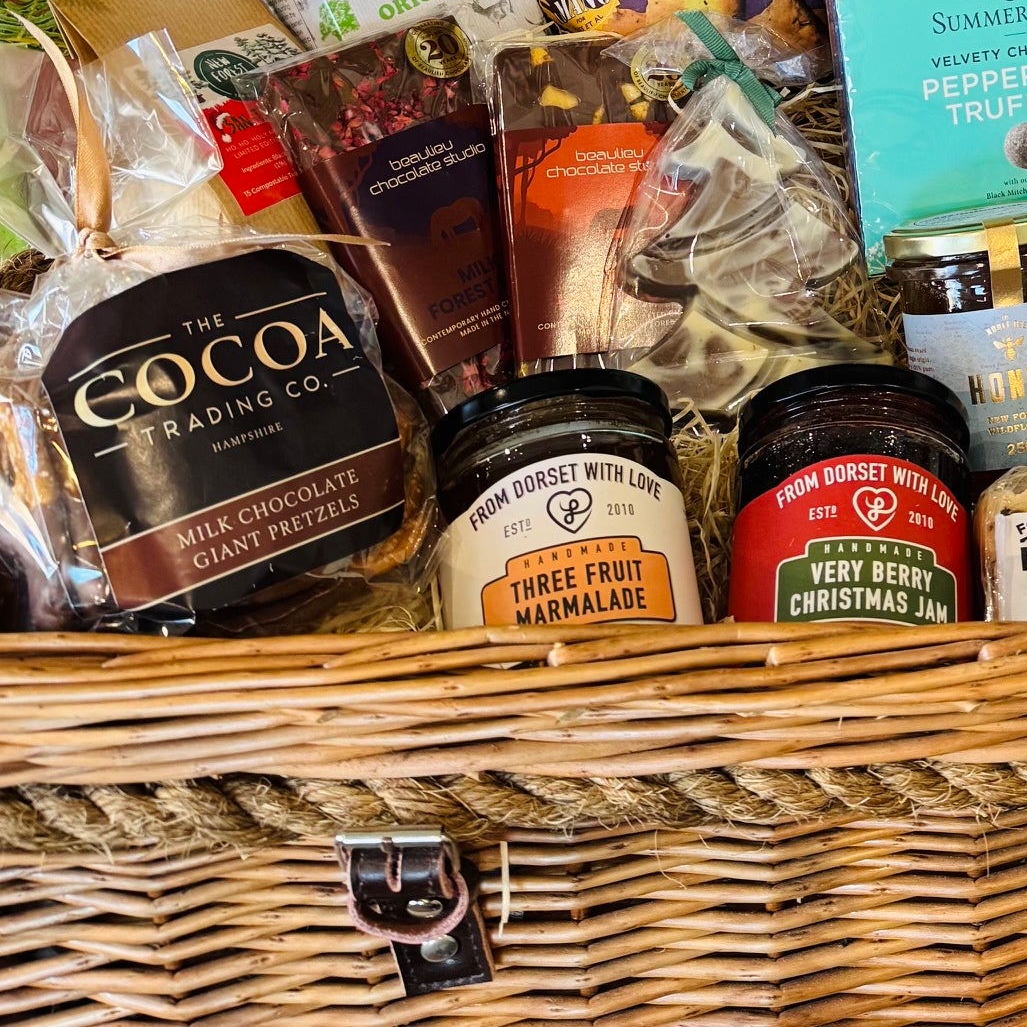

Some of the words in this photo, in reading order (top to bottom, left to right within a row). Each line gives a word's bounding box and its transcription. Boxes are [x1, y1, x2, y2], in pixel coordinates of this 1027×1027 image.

[931, 49, 1001, 68] VELVETY
[369, 162, 442, 196] chocolate
[444, 141, 486, 166] studio
[388, 139, 454, 171] beaulieu
[183, 313, 225, 335] THE
[74, 307, 354, 428] COCOA
[141, 391, 273, 446] TRADING
[286, 376, 328, 398] CO.
[212, 422, 283, 453] HAMPSHIRE
[177, 515, 233, 550] MILK
[237, 469, 359, 525] CHOCOLATE
[193, 530, 262, 570] GIANT
[270, 494, 360, 541] PRETZELS
[511, 567, 577, 604] THREE
[586, 560, 642, 585] FRUIT
[811, 560, 864, 584] VERY
[872, 561, 932, 592] BERRY
[516, 588, 647, 624] MARMALADE
[790, 587, 907, 616] CHRISTMAS
[915, 597, 948, 624] JAM
